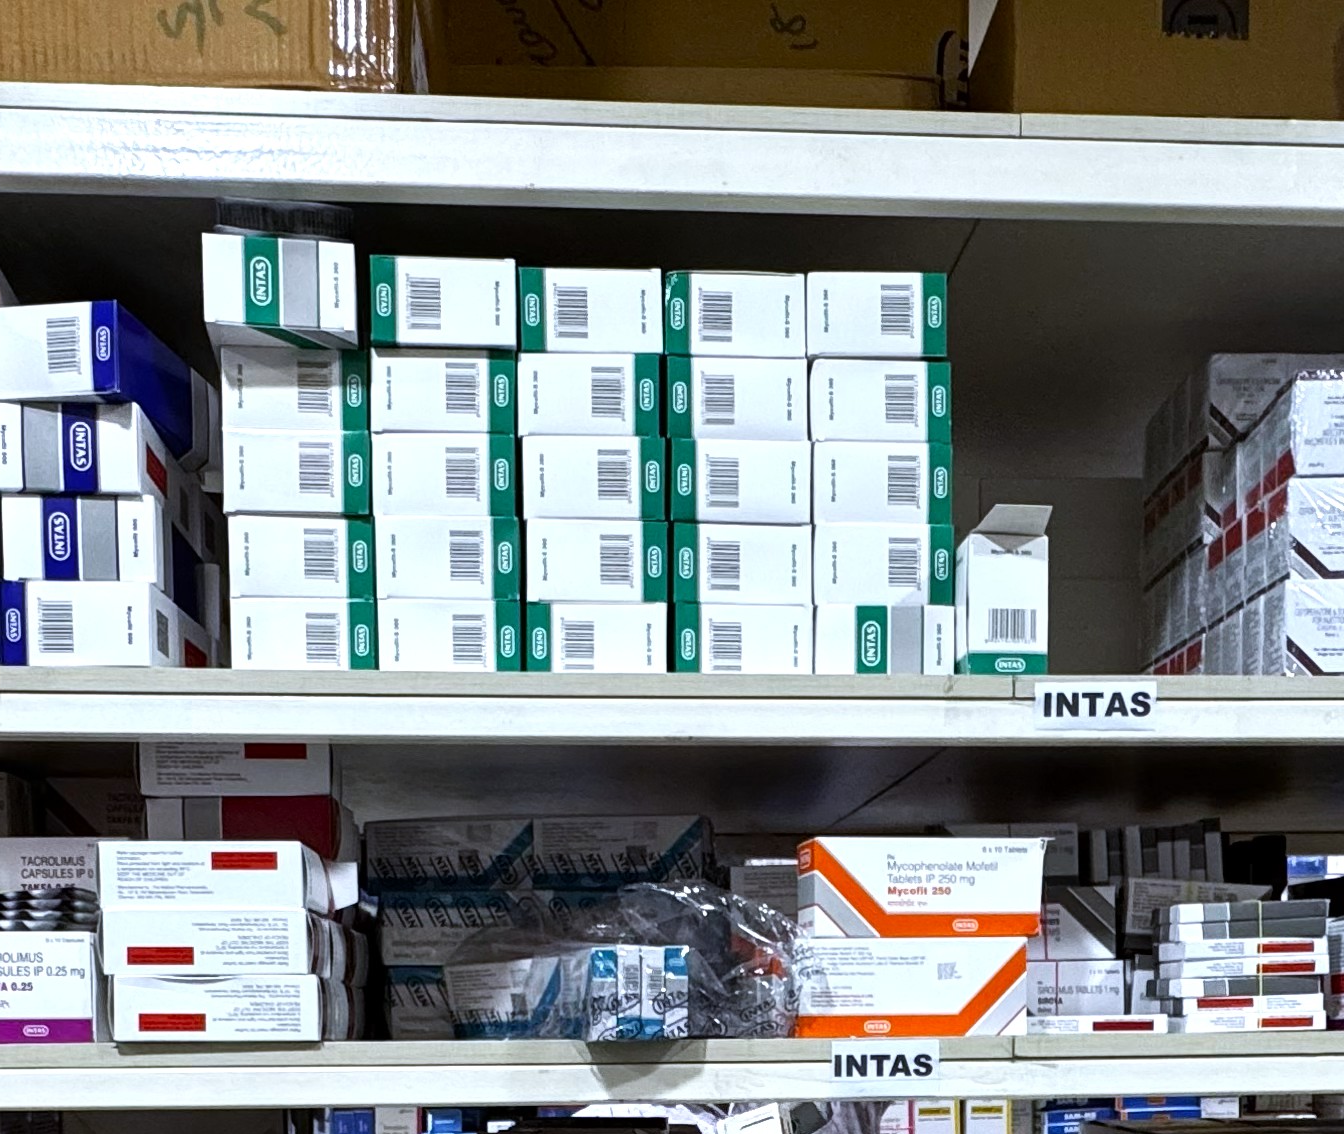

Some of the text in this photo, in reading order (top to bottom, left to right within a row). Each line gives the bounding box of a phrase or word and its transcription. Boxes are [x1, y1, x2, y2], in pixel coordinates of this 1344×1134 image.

[254, 259, 268, 302] INTAS
[73, 425, 89, 468] INTAS
[52, 515, 67, 558] INTAS
[864, 625, 878, 663] INTAS
[1043, 691, 1152, 717] INTAS
[887, 861, 998, 873] Mycophenolate Mofetil
[887, 875, 975, 886] Tablets IP 250 mg
[887, 887, 951, 897] Mycofit 250
[33, 967, 45, 976] IP
[47, 967, 68, 976] 0.25
[70, 967, 85, 979] mg
[11, 982, 33, 991] 0.25
[834, 1054, 933, 1077] INTAS
